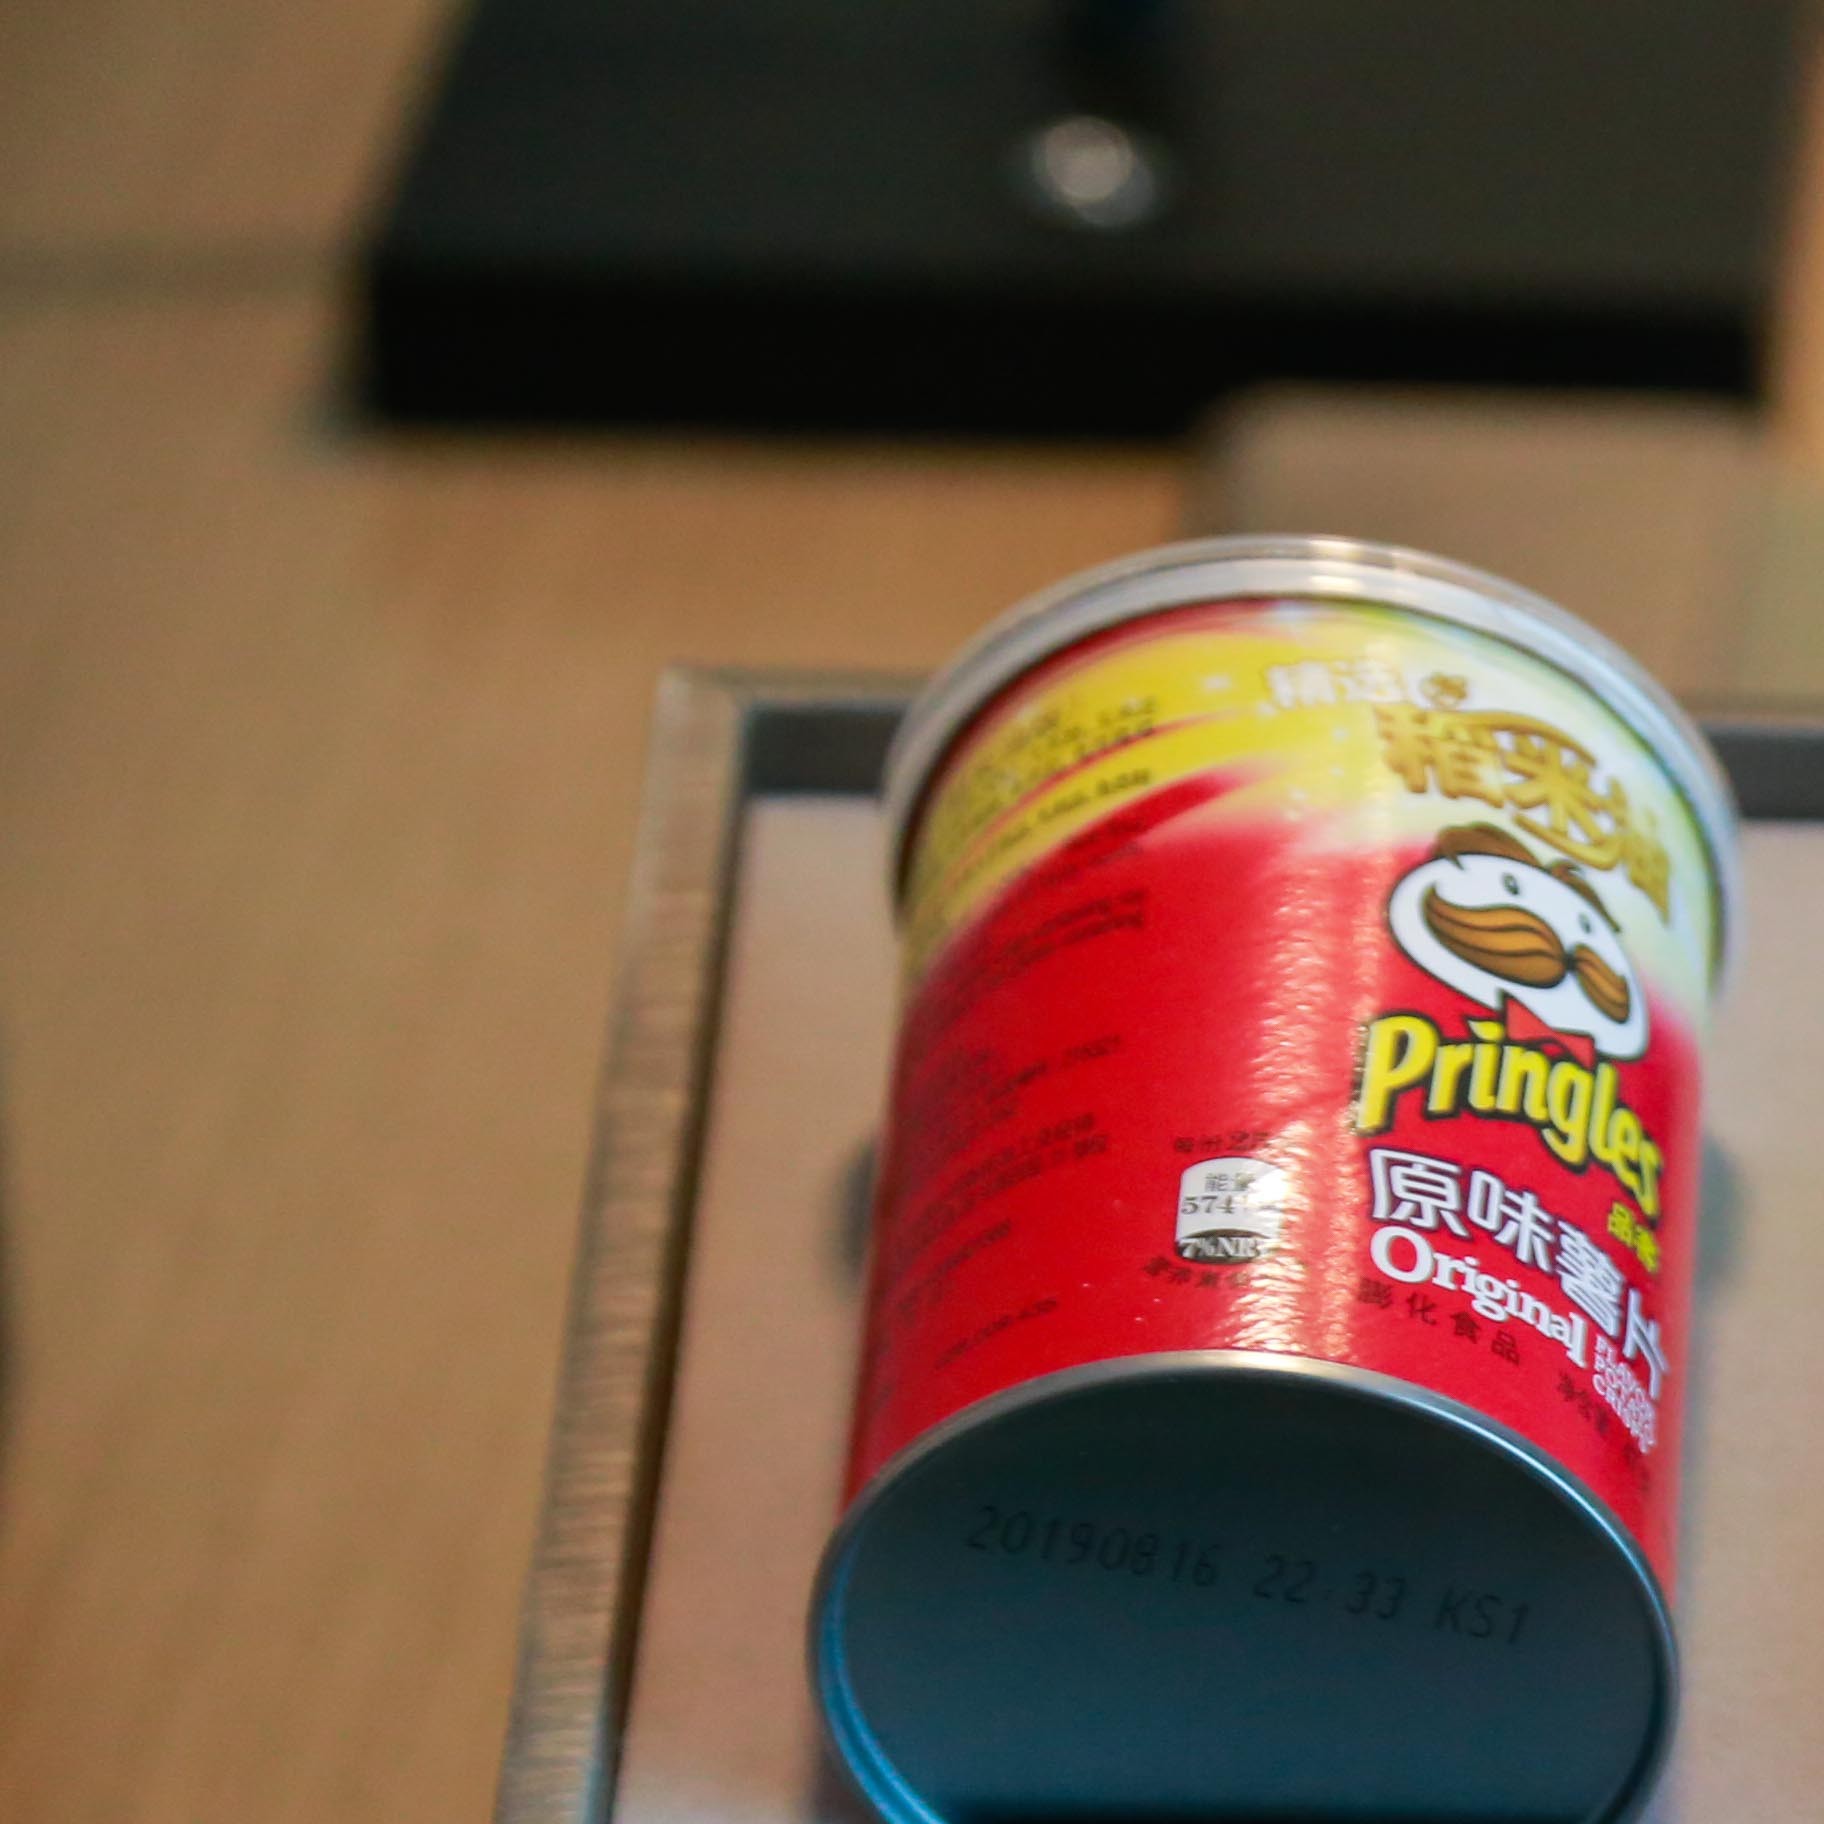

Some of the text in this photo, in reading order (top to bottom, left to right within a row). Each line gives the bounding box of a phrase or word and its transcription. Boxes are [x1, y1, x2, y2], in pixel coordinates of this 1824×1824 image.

[1355, 1012, 1663, 1218] Pringles
[1369, 1147, 1668, 1398] 原味薯片
[1370, 1226, 1590, 1369] Original
[965, 1504, 1221, 1589] 20190816
